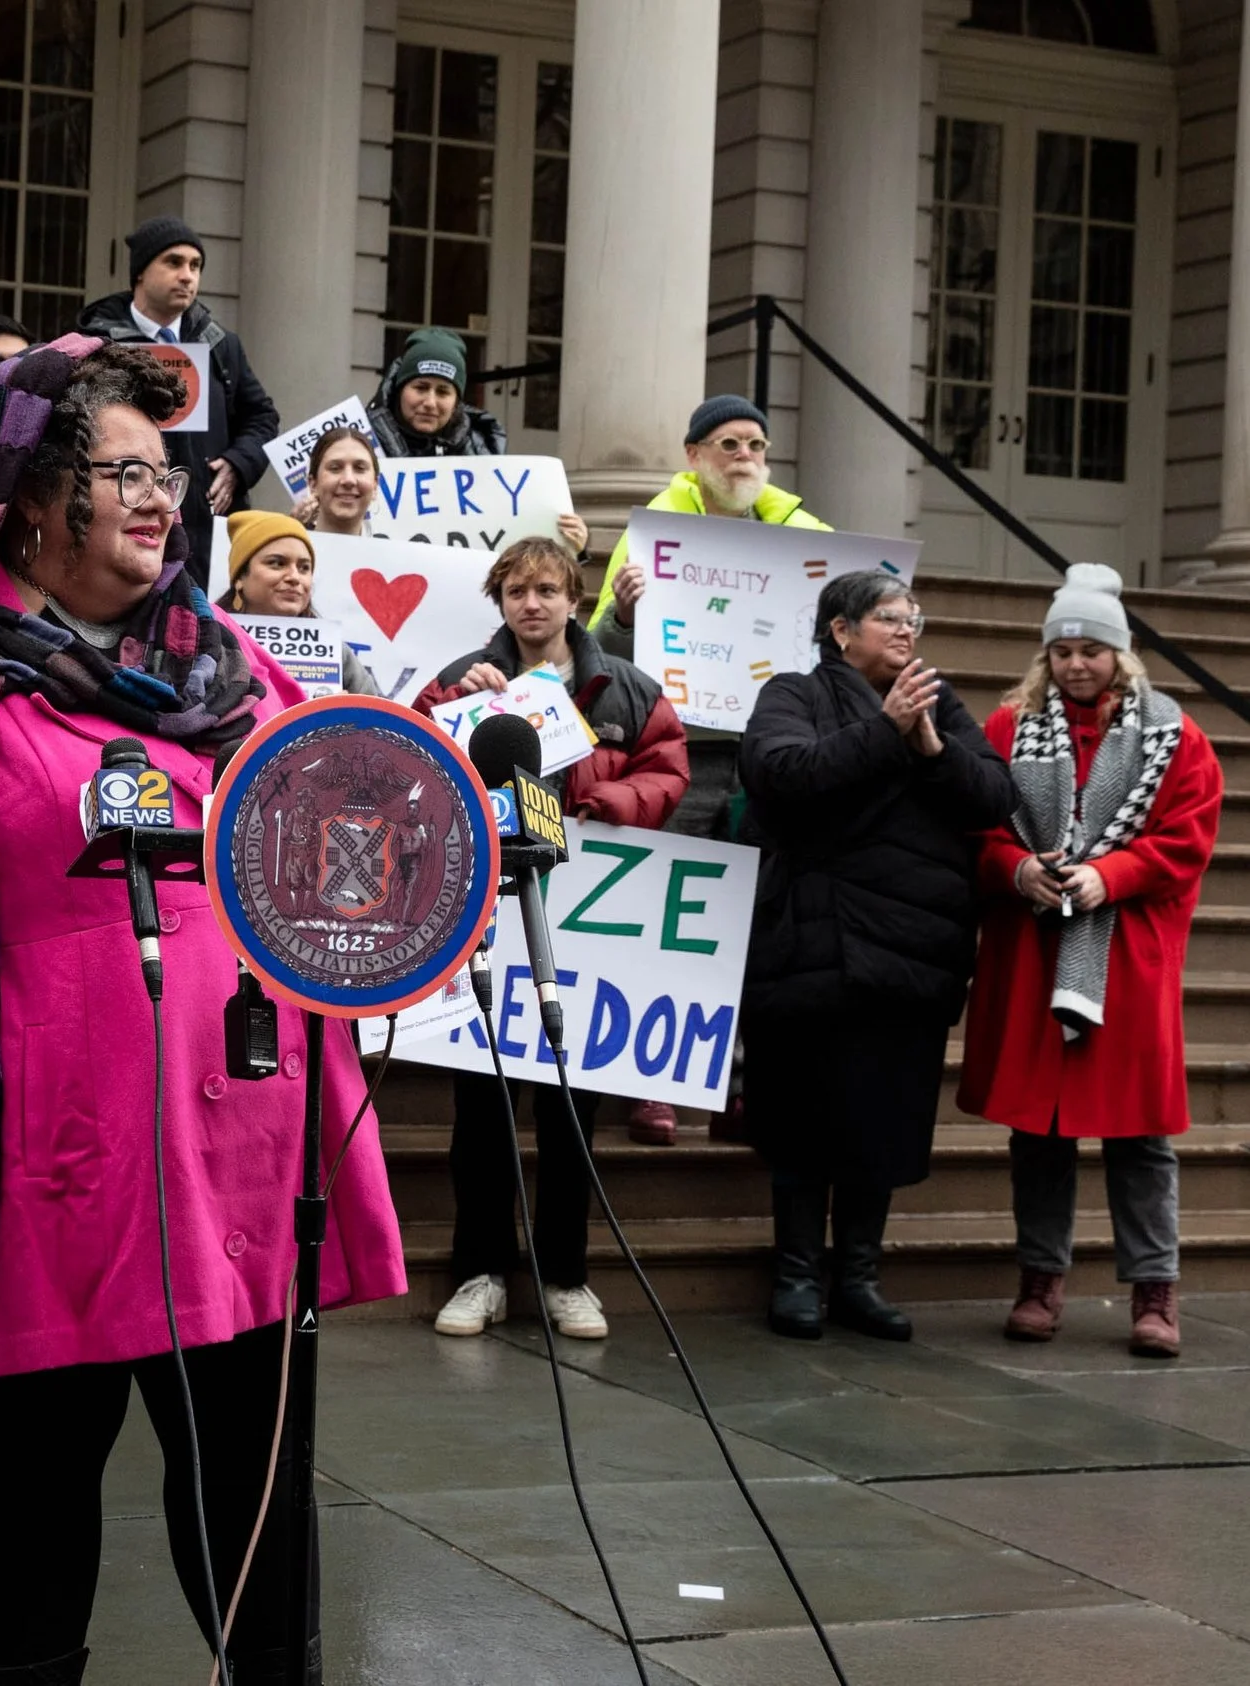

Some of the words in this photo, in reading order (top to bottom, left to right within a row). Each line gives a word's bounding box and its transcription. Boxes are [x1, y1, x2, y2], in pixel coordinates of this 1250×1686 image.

[286, 428, 322, 452] YES
[321, 412, 348, 434] ON
[365, 468, 531, 520] VERY
[654, 539, 771, 594] EQUALITY
[706, 596, 733, 614] AT
[269, 642, 334, 658] 0209!
[286, 628, 319, 642] ON
[137, 770, 170, 809] 2
[518, 776, 562, 824] 1010
[102, 808, 172, 825] NEWS
[523, 804, 566, 849] WINS
[327, 933, 376, 952] 1625
